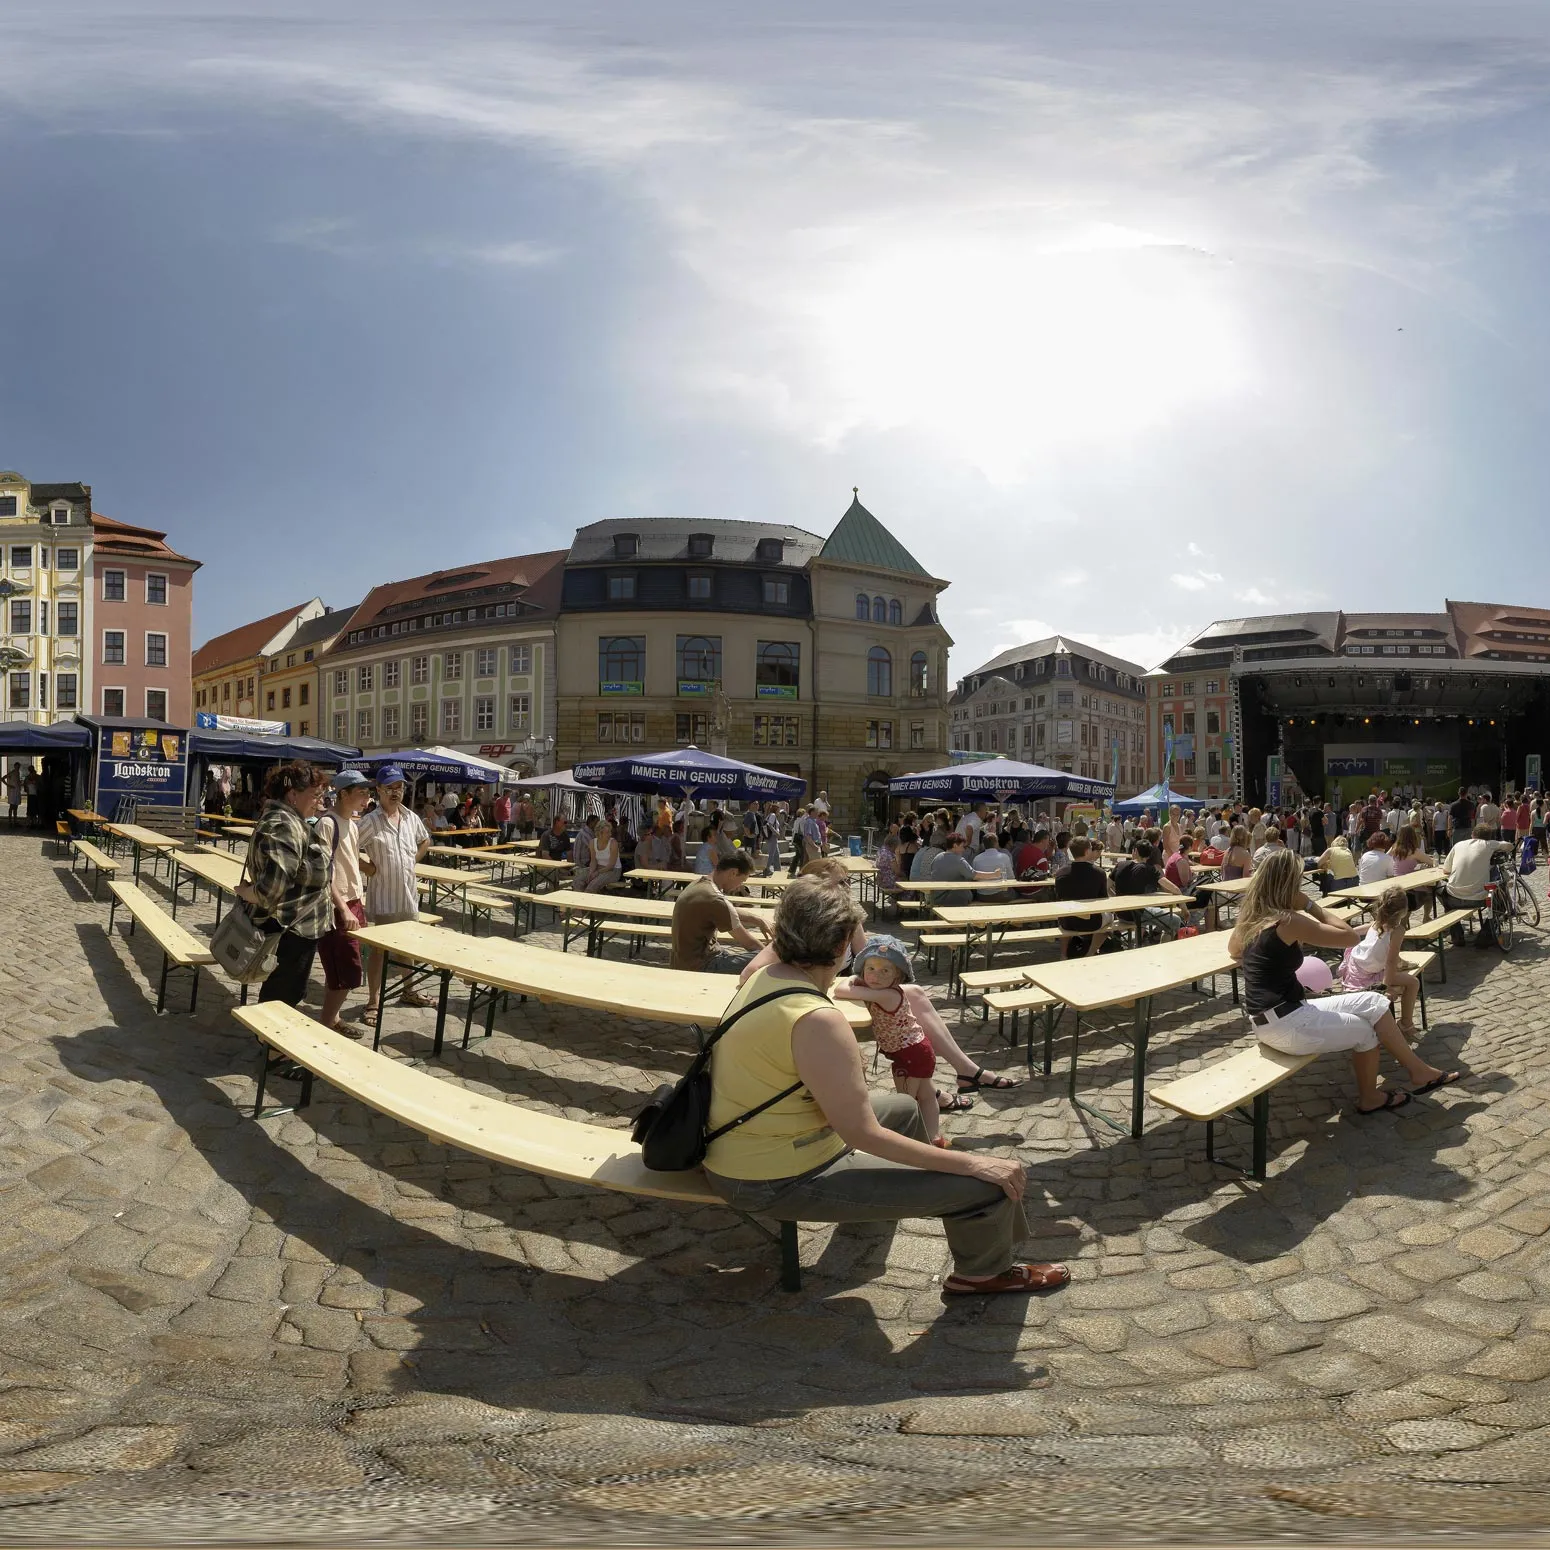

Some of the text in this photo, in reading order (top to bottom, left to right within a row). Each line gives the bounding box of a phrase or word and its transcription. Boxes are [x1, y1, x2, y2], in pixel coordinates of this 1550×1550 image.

[479, 744, 515, 757] ego
[112, 763, 171, 778] Landskron
[430, 764, 461, 774] GENUSS!
[1328, 758, 1368, 770] mdr
[574, 765, 605, 779] Landskron
[631, 765, 738, 784] IMMER EIN GENUSS!
[745, 772, 778, 789] Landskron
[909, 780, 921, 790] EIN
[922, 779, 952, 790] GENUSS!
[962, 777, 1020, 791] Landskron
[1092, 787, 1115, 797] GENUSS!
